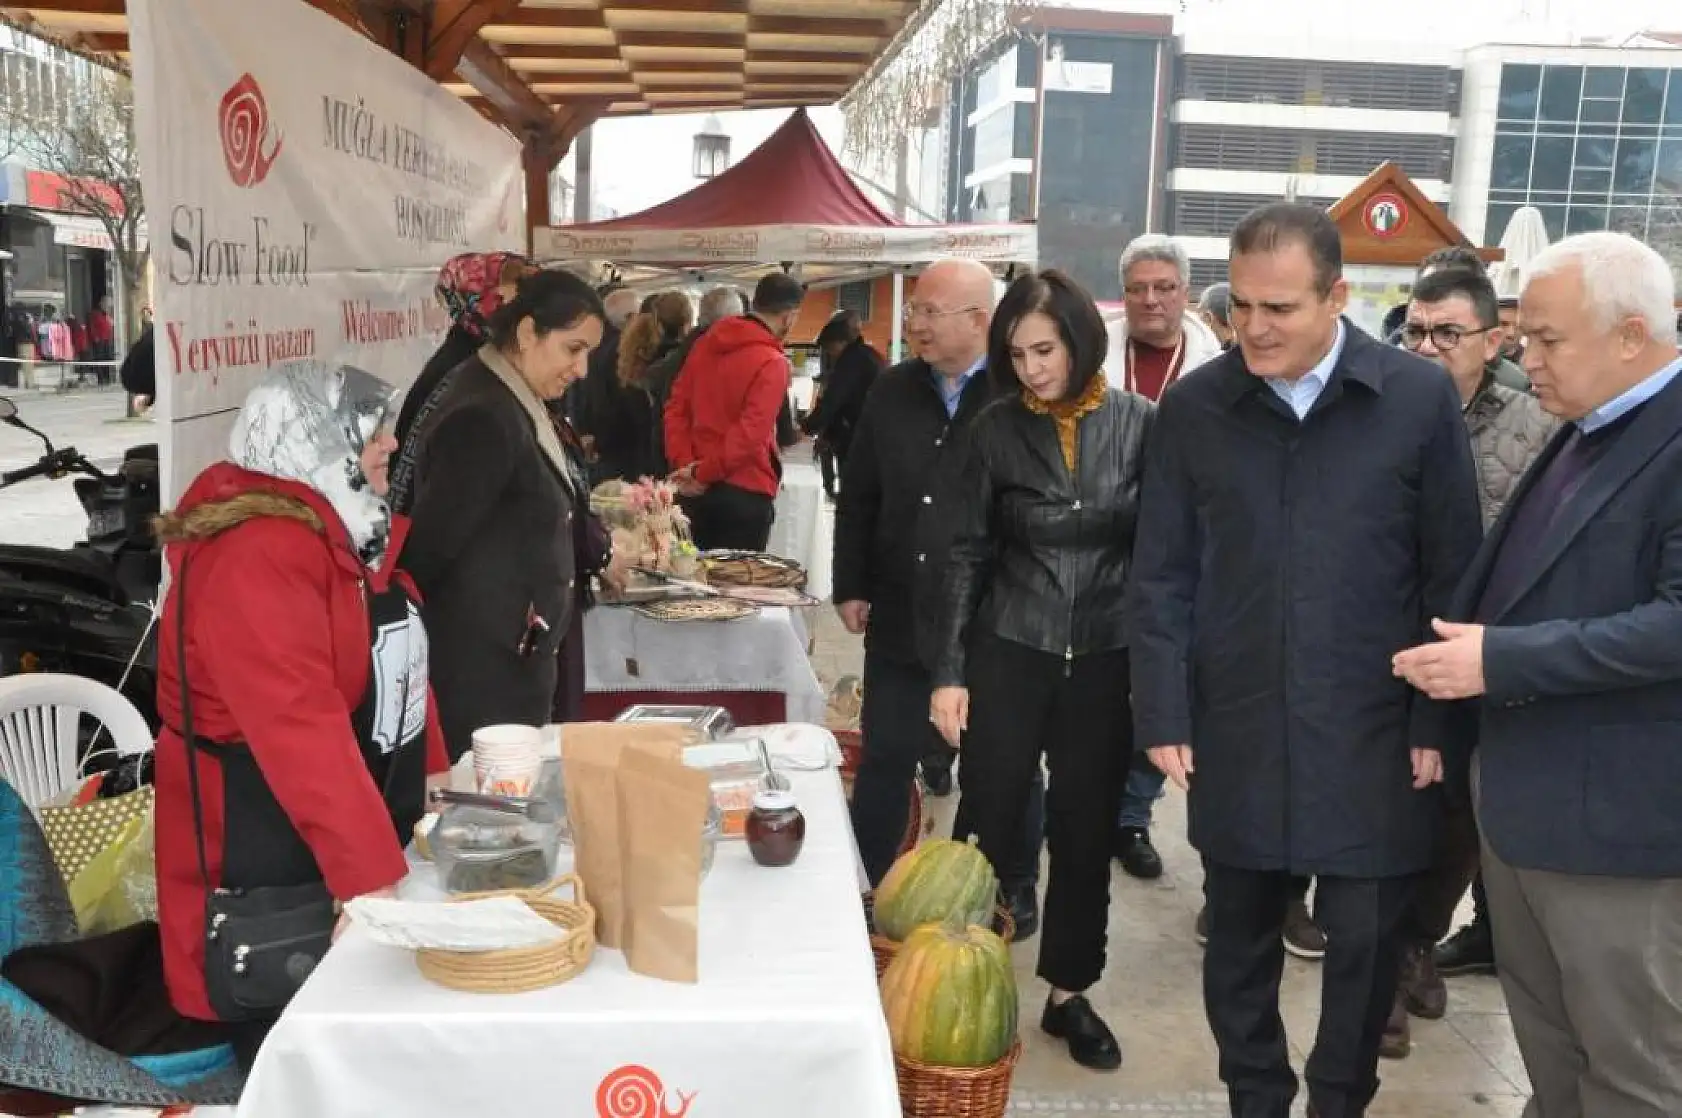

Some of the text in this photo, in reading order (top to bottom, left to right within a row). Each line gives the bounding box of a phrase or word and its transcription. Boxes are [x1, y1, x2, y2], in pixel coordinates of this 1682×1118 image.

[322, 95, 388, 165] MUĞLA
[169, 204, 246, 286] Slow
[166, 316, 260, 385] Yeryüzü
[342, 298, 405, 343] Welcome
